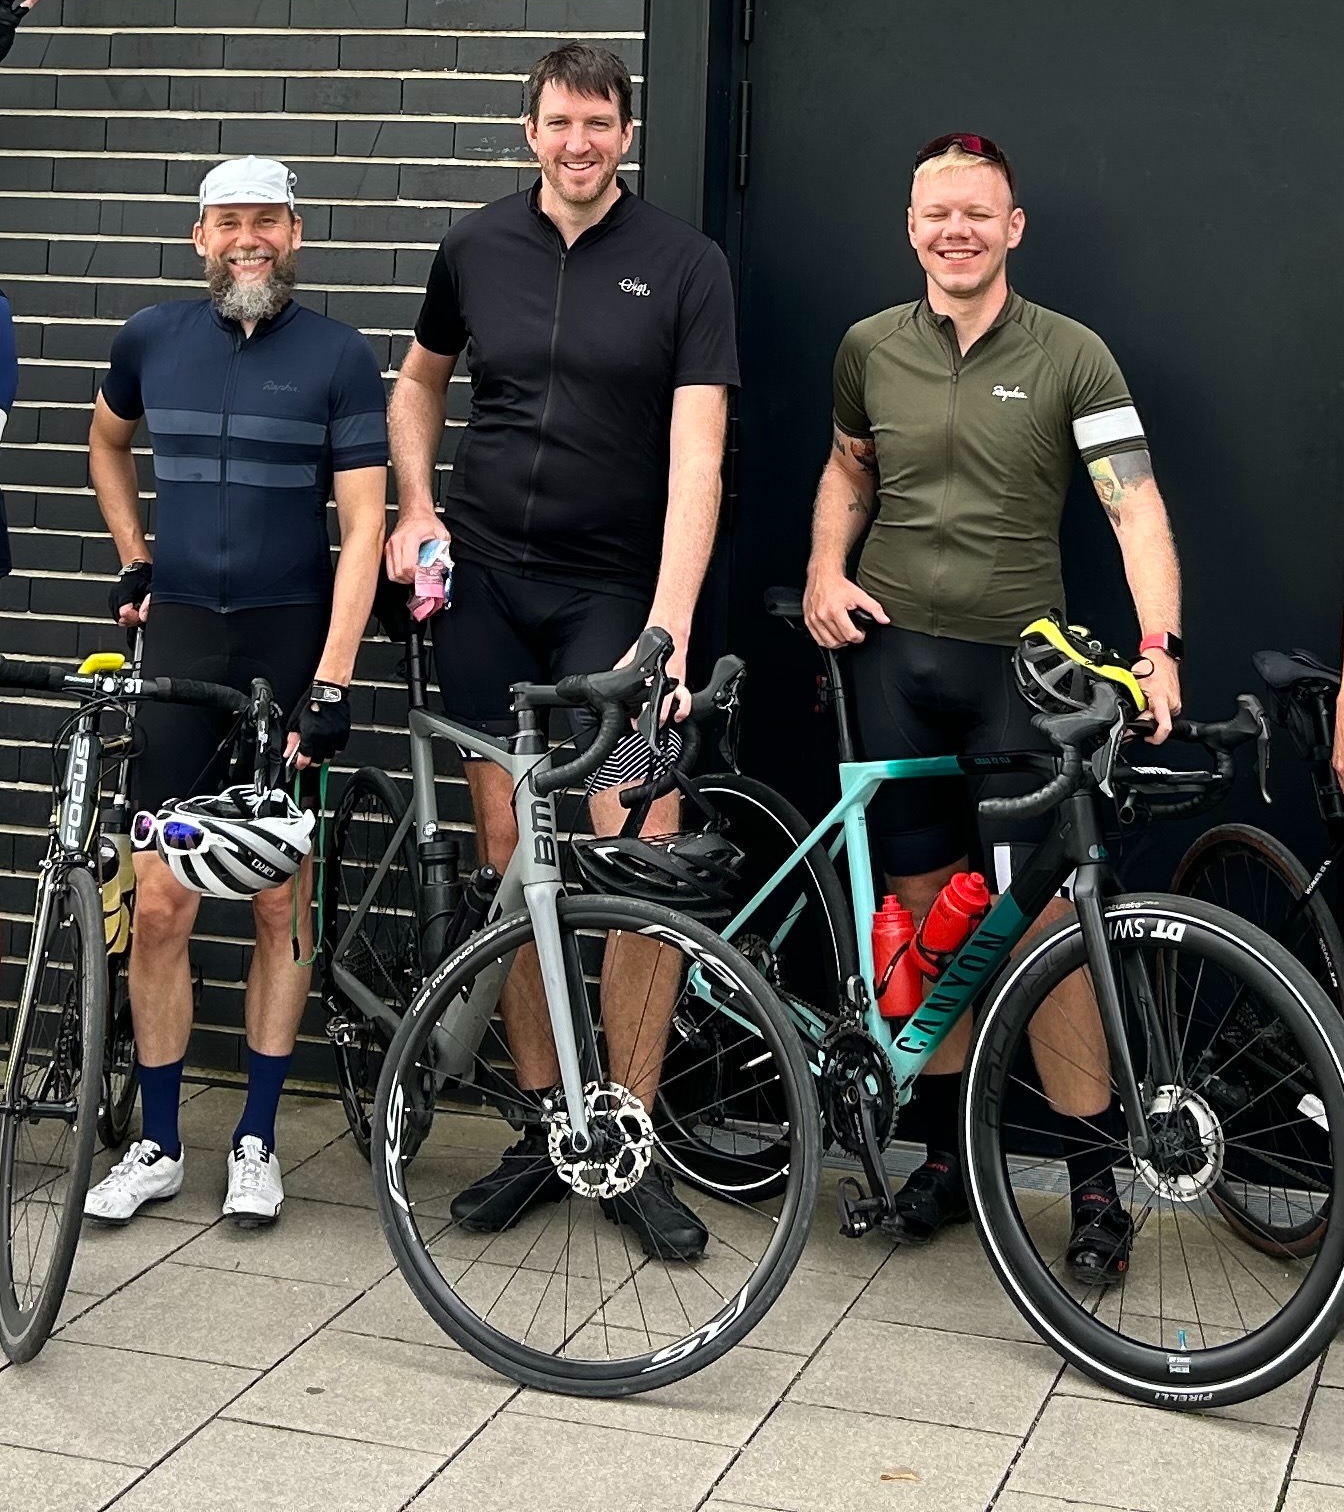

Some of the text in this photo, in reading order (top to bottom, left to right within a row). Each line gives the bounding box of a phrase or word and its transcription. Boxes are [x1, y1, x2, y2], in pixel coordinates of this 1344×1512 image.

[66, 738, 91, 848] FOCUS
[1150, 919, 1187, 943] DT
[896, 929, 1006, 1055] CANYON
[1154, 1391, 1214, 1402] PIRELLI
